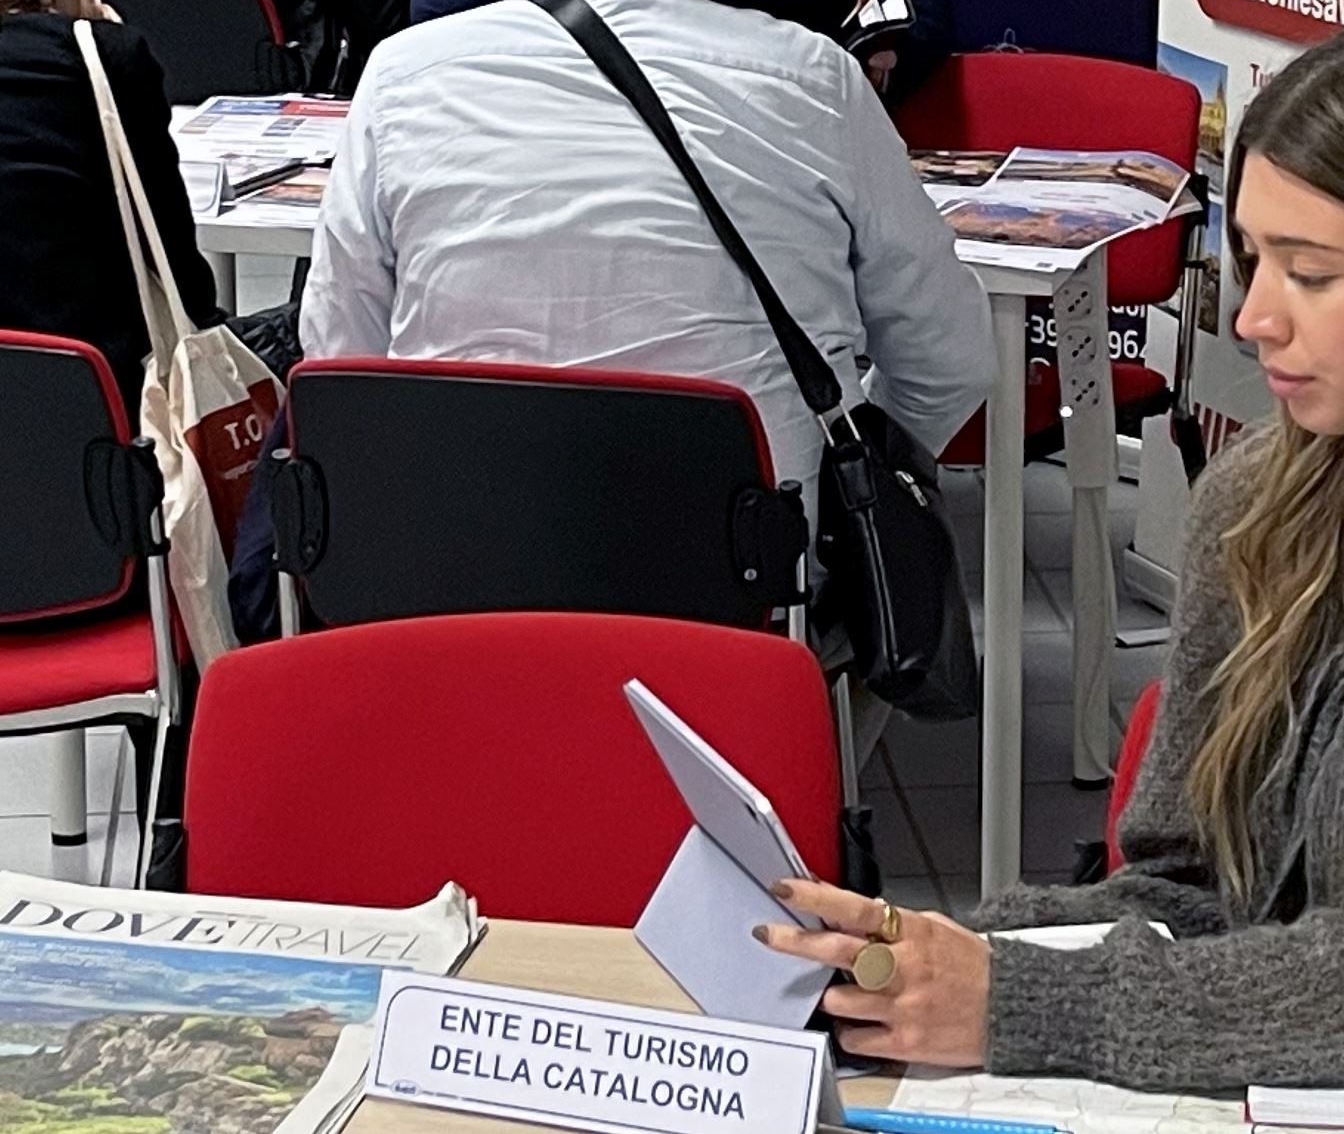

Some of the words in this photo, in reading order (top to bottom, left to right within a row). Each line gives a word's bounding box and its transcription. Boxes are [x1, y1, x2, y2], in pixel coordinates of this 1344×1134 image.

[231, 918, 428, 962] TRAVEL
[439, 1004, 522, 1042] ENTE
[531, 1017, 592, 1053] DEL
[604, 1028, 750, 1077] TURISMO
[429, 1044, 531, 1085] DELLA
[542, 1062, 746, 1120] CATALOGNA
